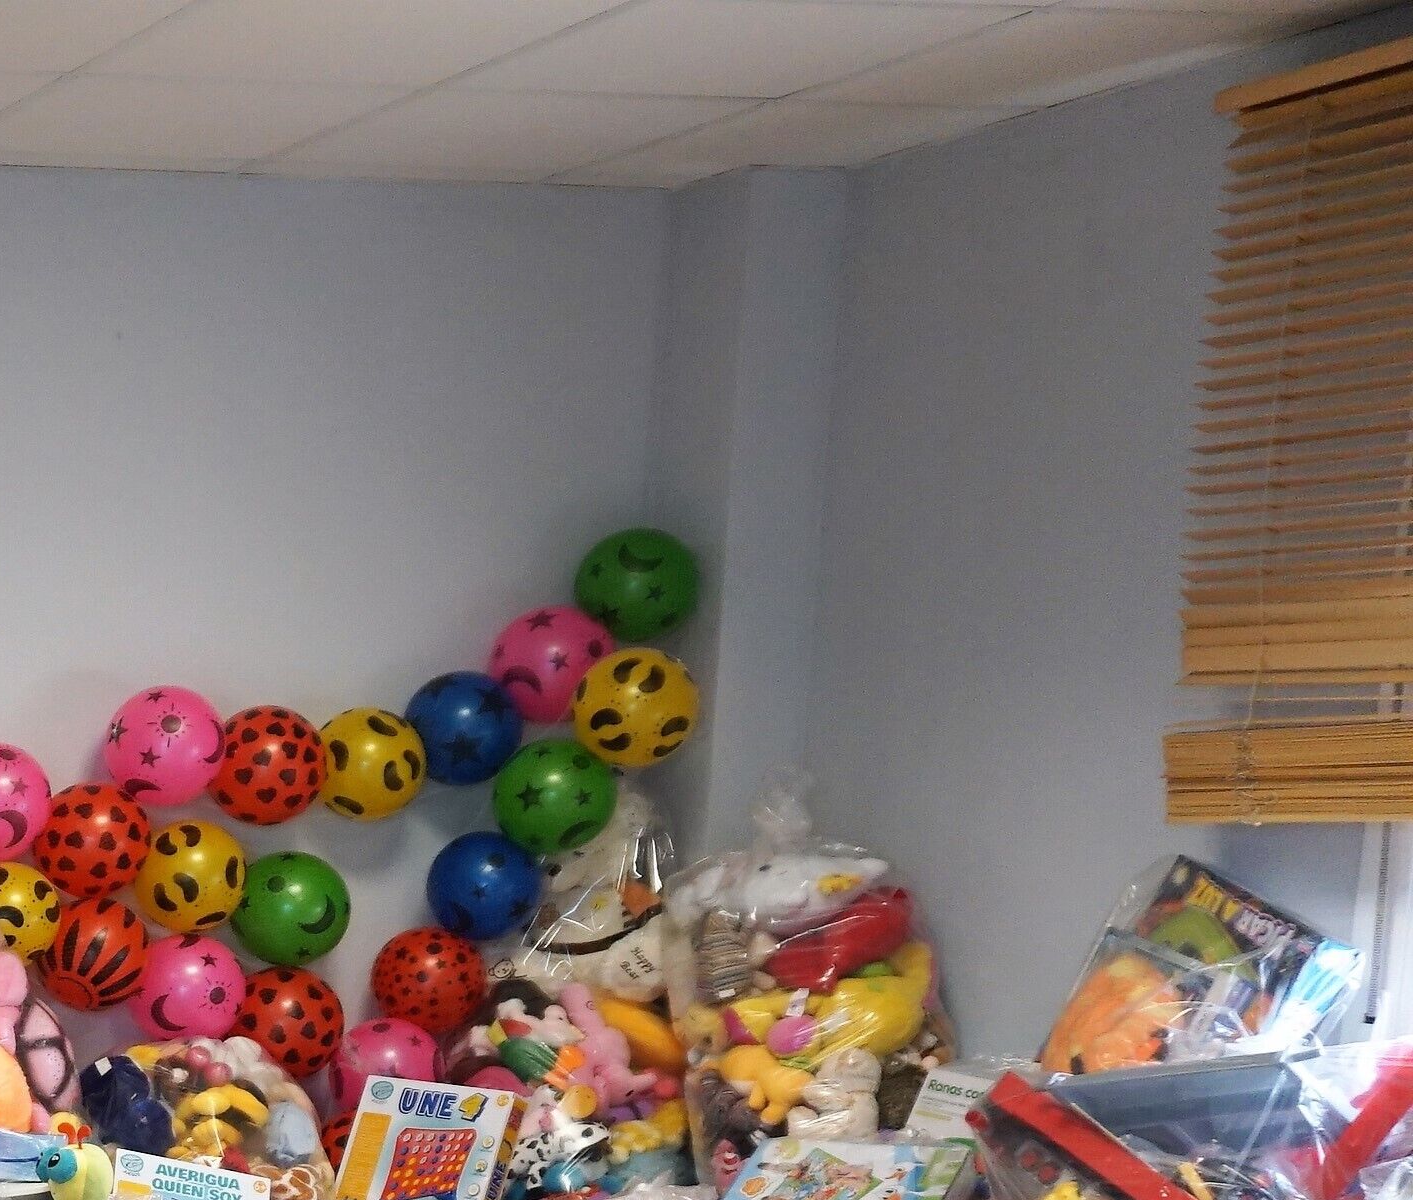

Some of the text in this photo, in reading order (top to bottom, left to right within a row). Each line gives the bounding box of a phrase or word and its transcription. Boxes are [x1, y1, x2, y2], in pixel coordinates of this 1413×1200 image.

[928, 1078, 963, 1097] Ranas
[399, 1087, 489, 1122] UNE 4
[151, 1177, 205, 1200] QUIEN
[155, 1163, 242, 1192] AVERIGUA
[486, 1161, 507, 1200] UNE
